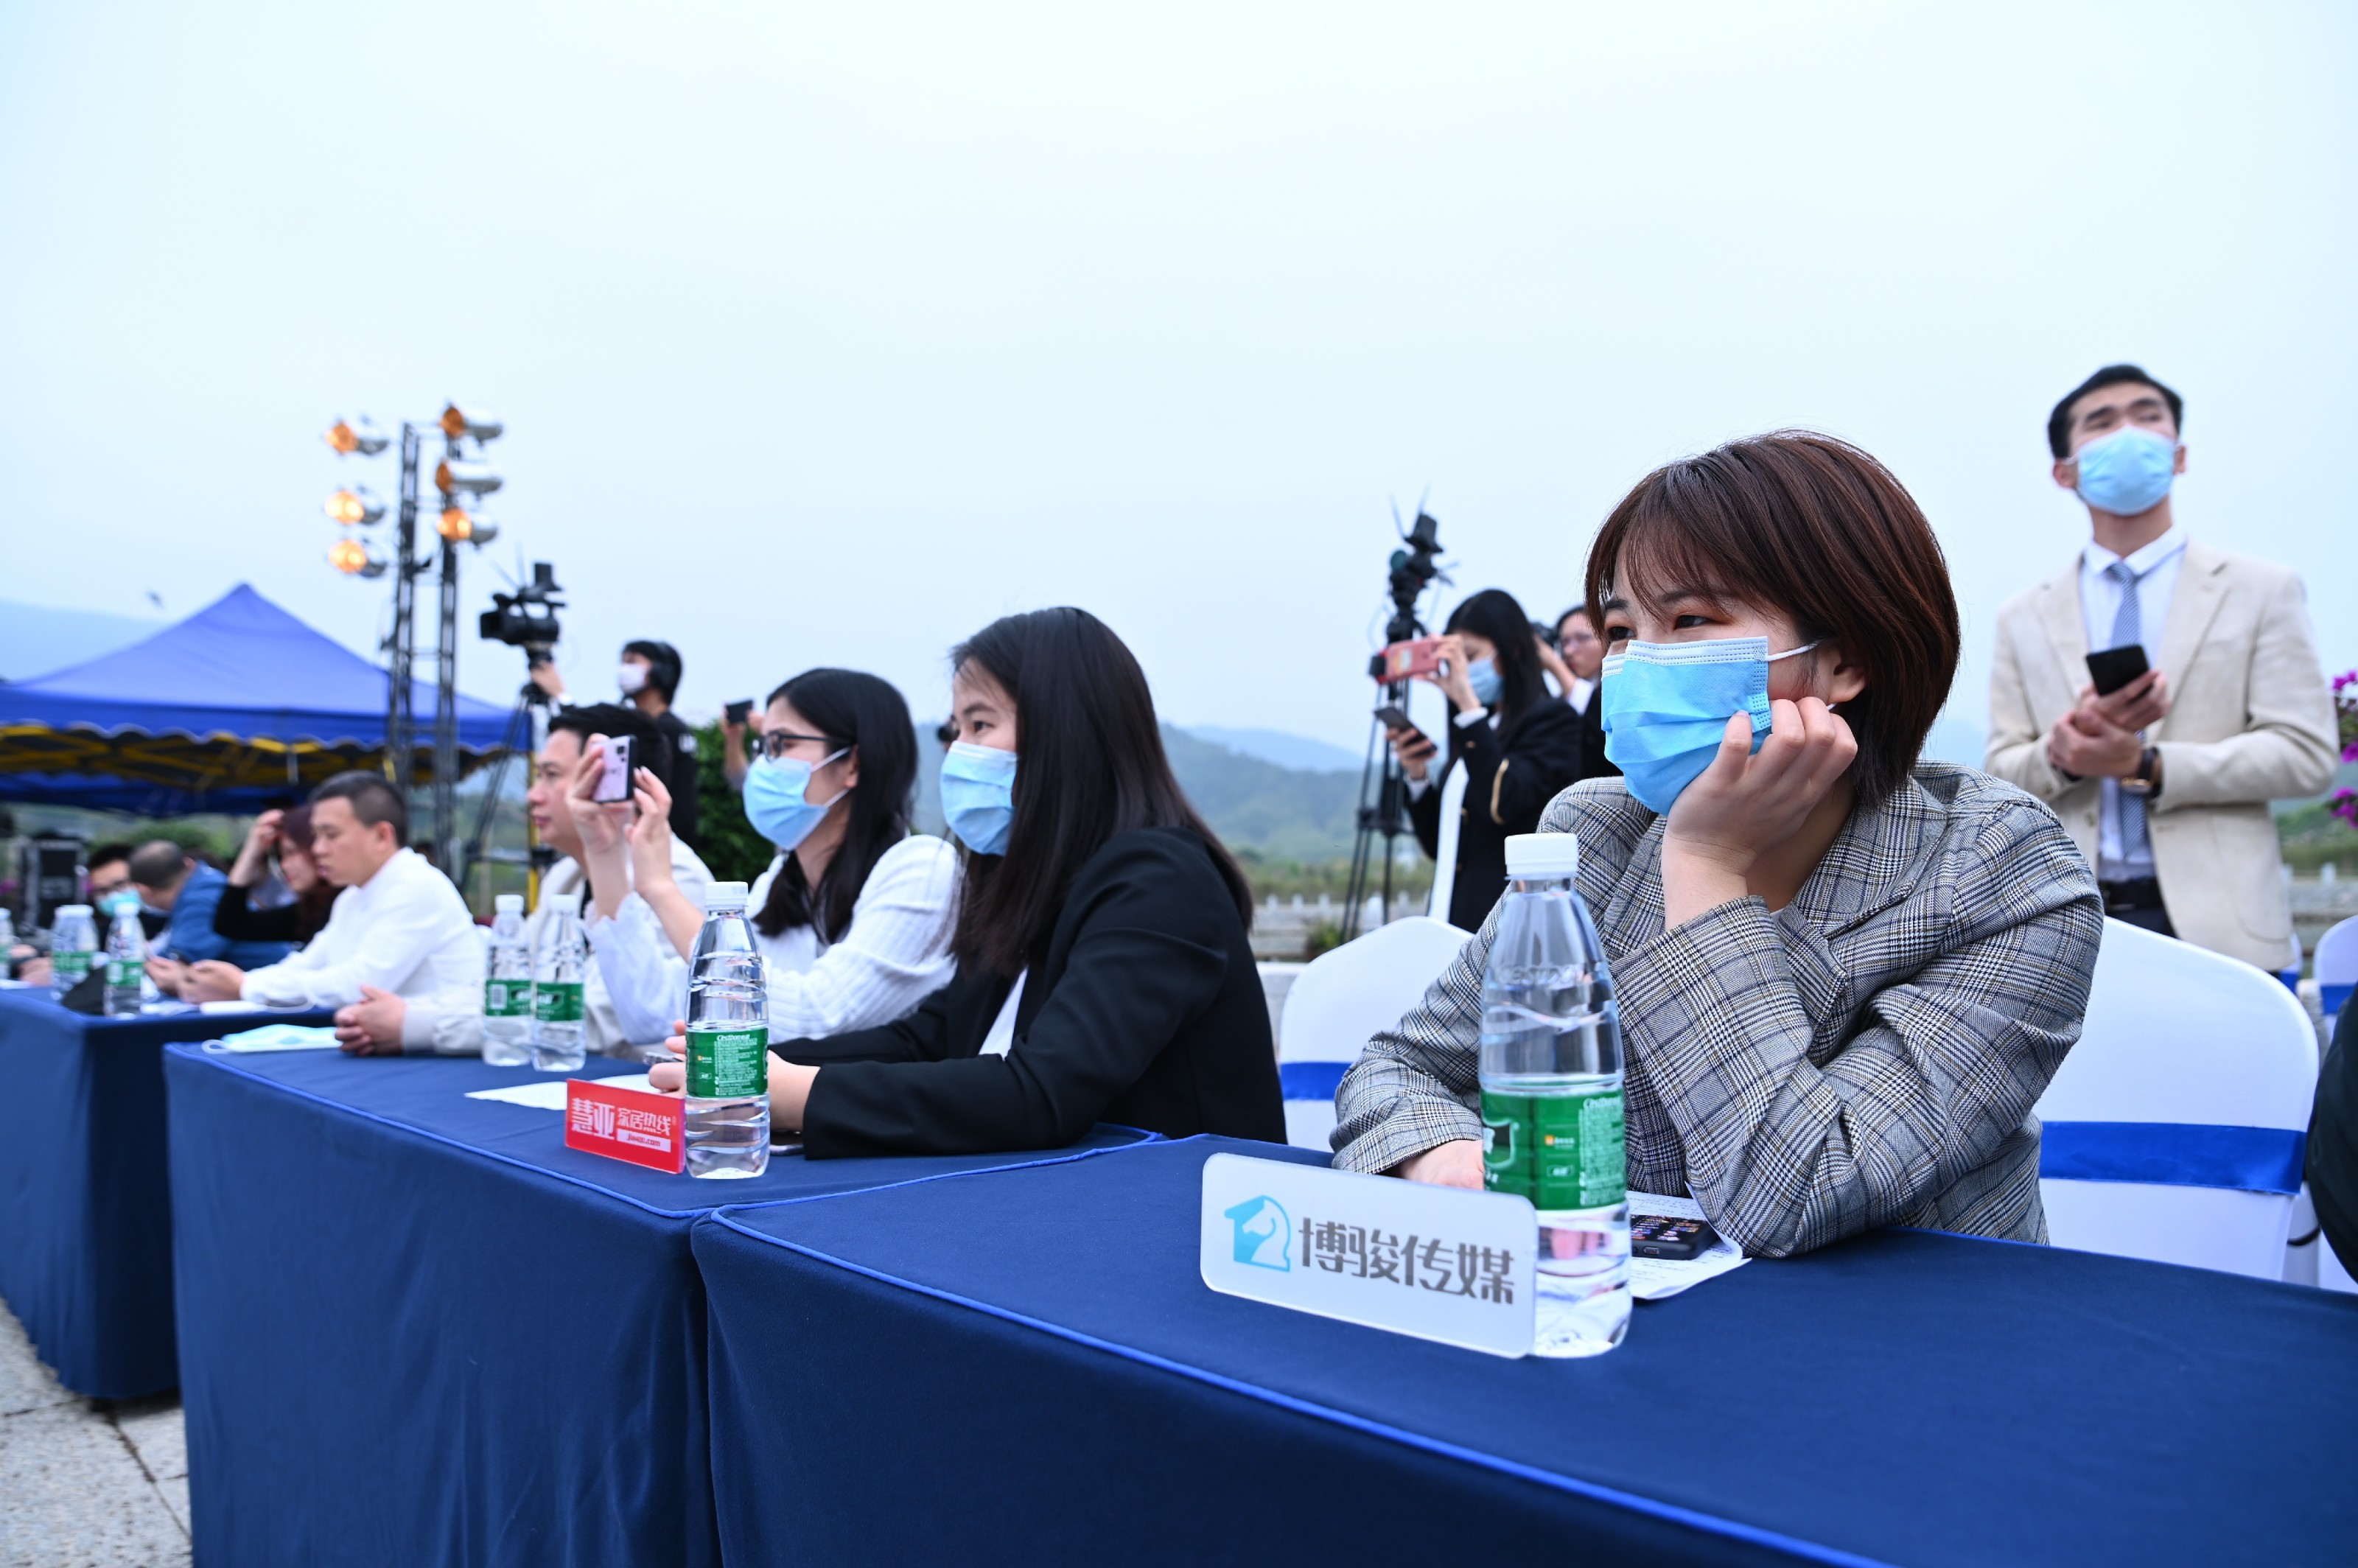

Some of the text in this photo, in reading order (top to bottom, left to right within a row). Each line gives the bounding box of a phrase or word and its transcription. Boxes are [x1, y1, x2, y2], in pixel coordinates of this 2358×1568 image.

[571, 1097, 671, 1140] 慧亚 家居热线
[1298, 1217, 1515, 1305] 博骏传媒
